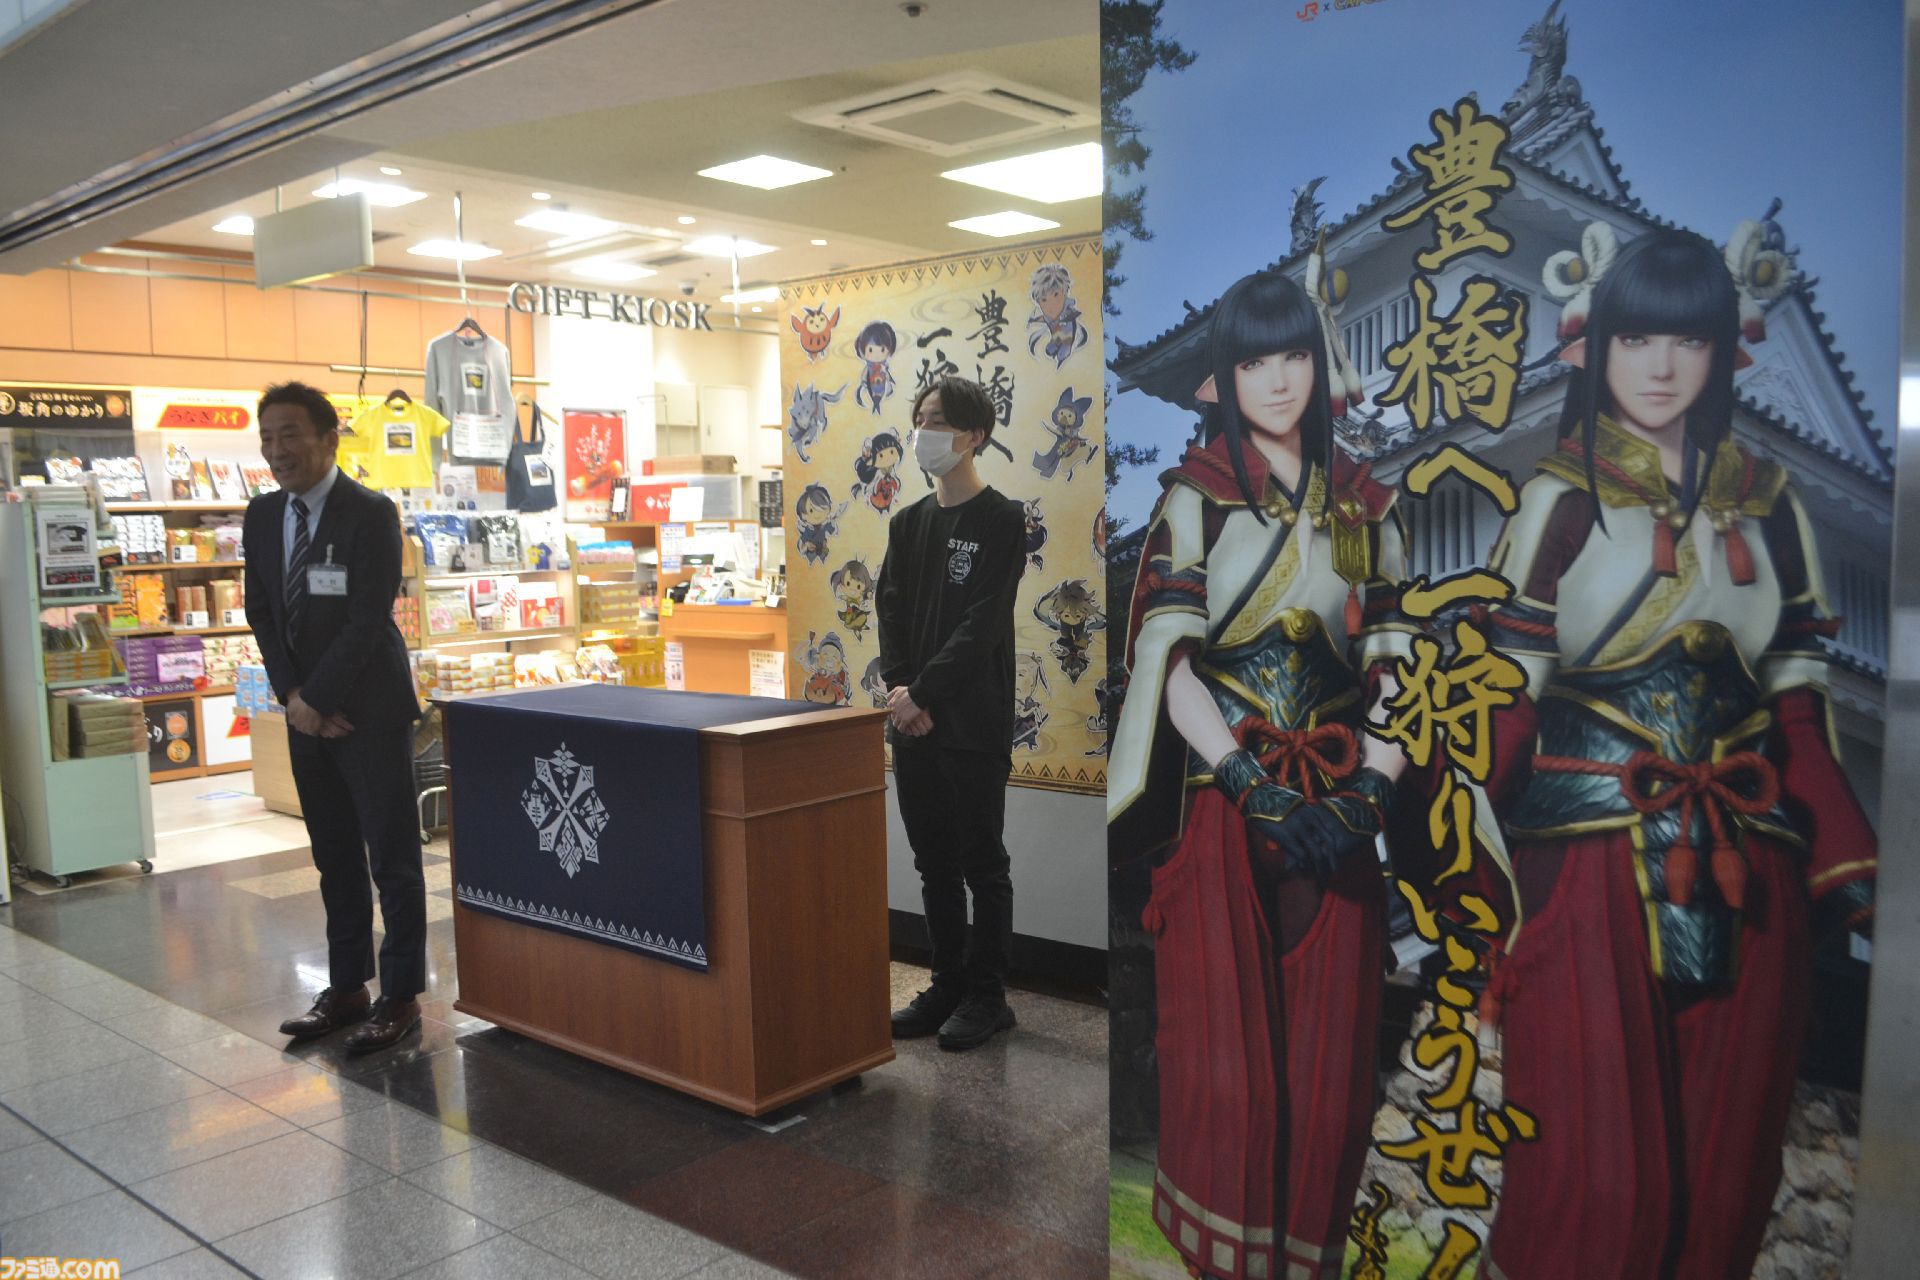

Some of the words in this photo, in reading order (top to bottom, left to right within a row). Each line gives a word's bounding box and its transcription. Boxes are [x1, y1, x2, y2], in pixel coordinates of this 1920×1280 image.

[508, 282, 598, 319] GIFT
[608, 292, 713, 331] KIOSK
[948, 538, 979, 553] STAFF
